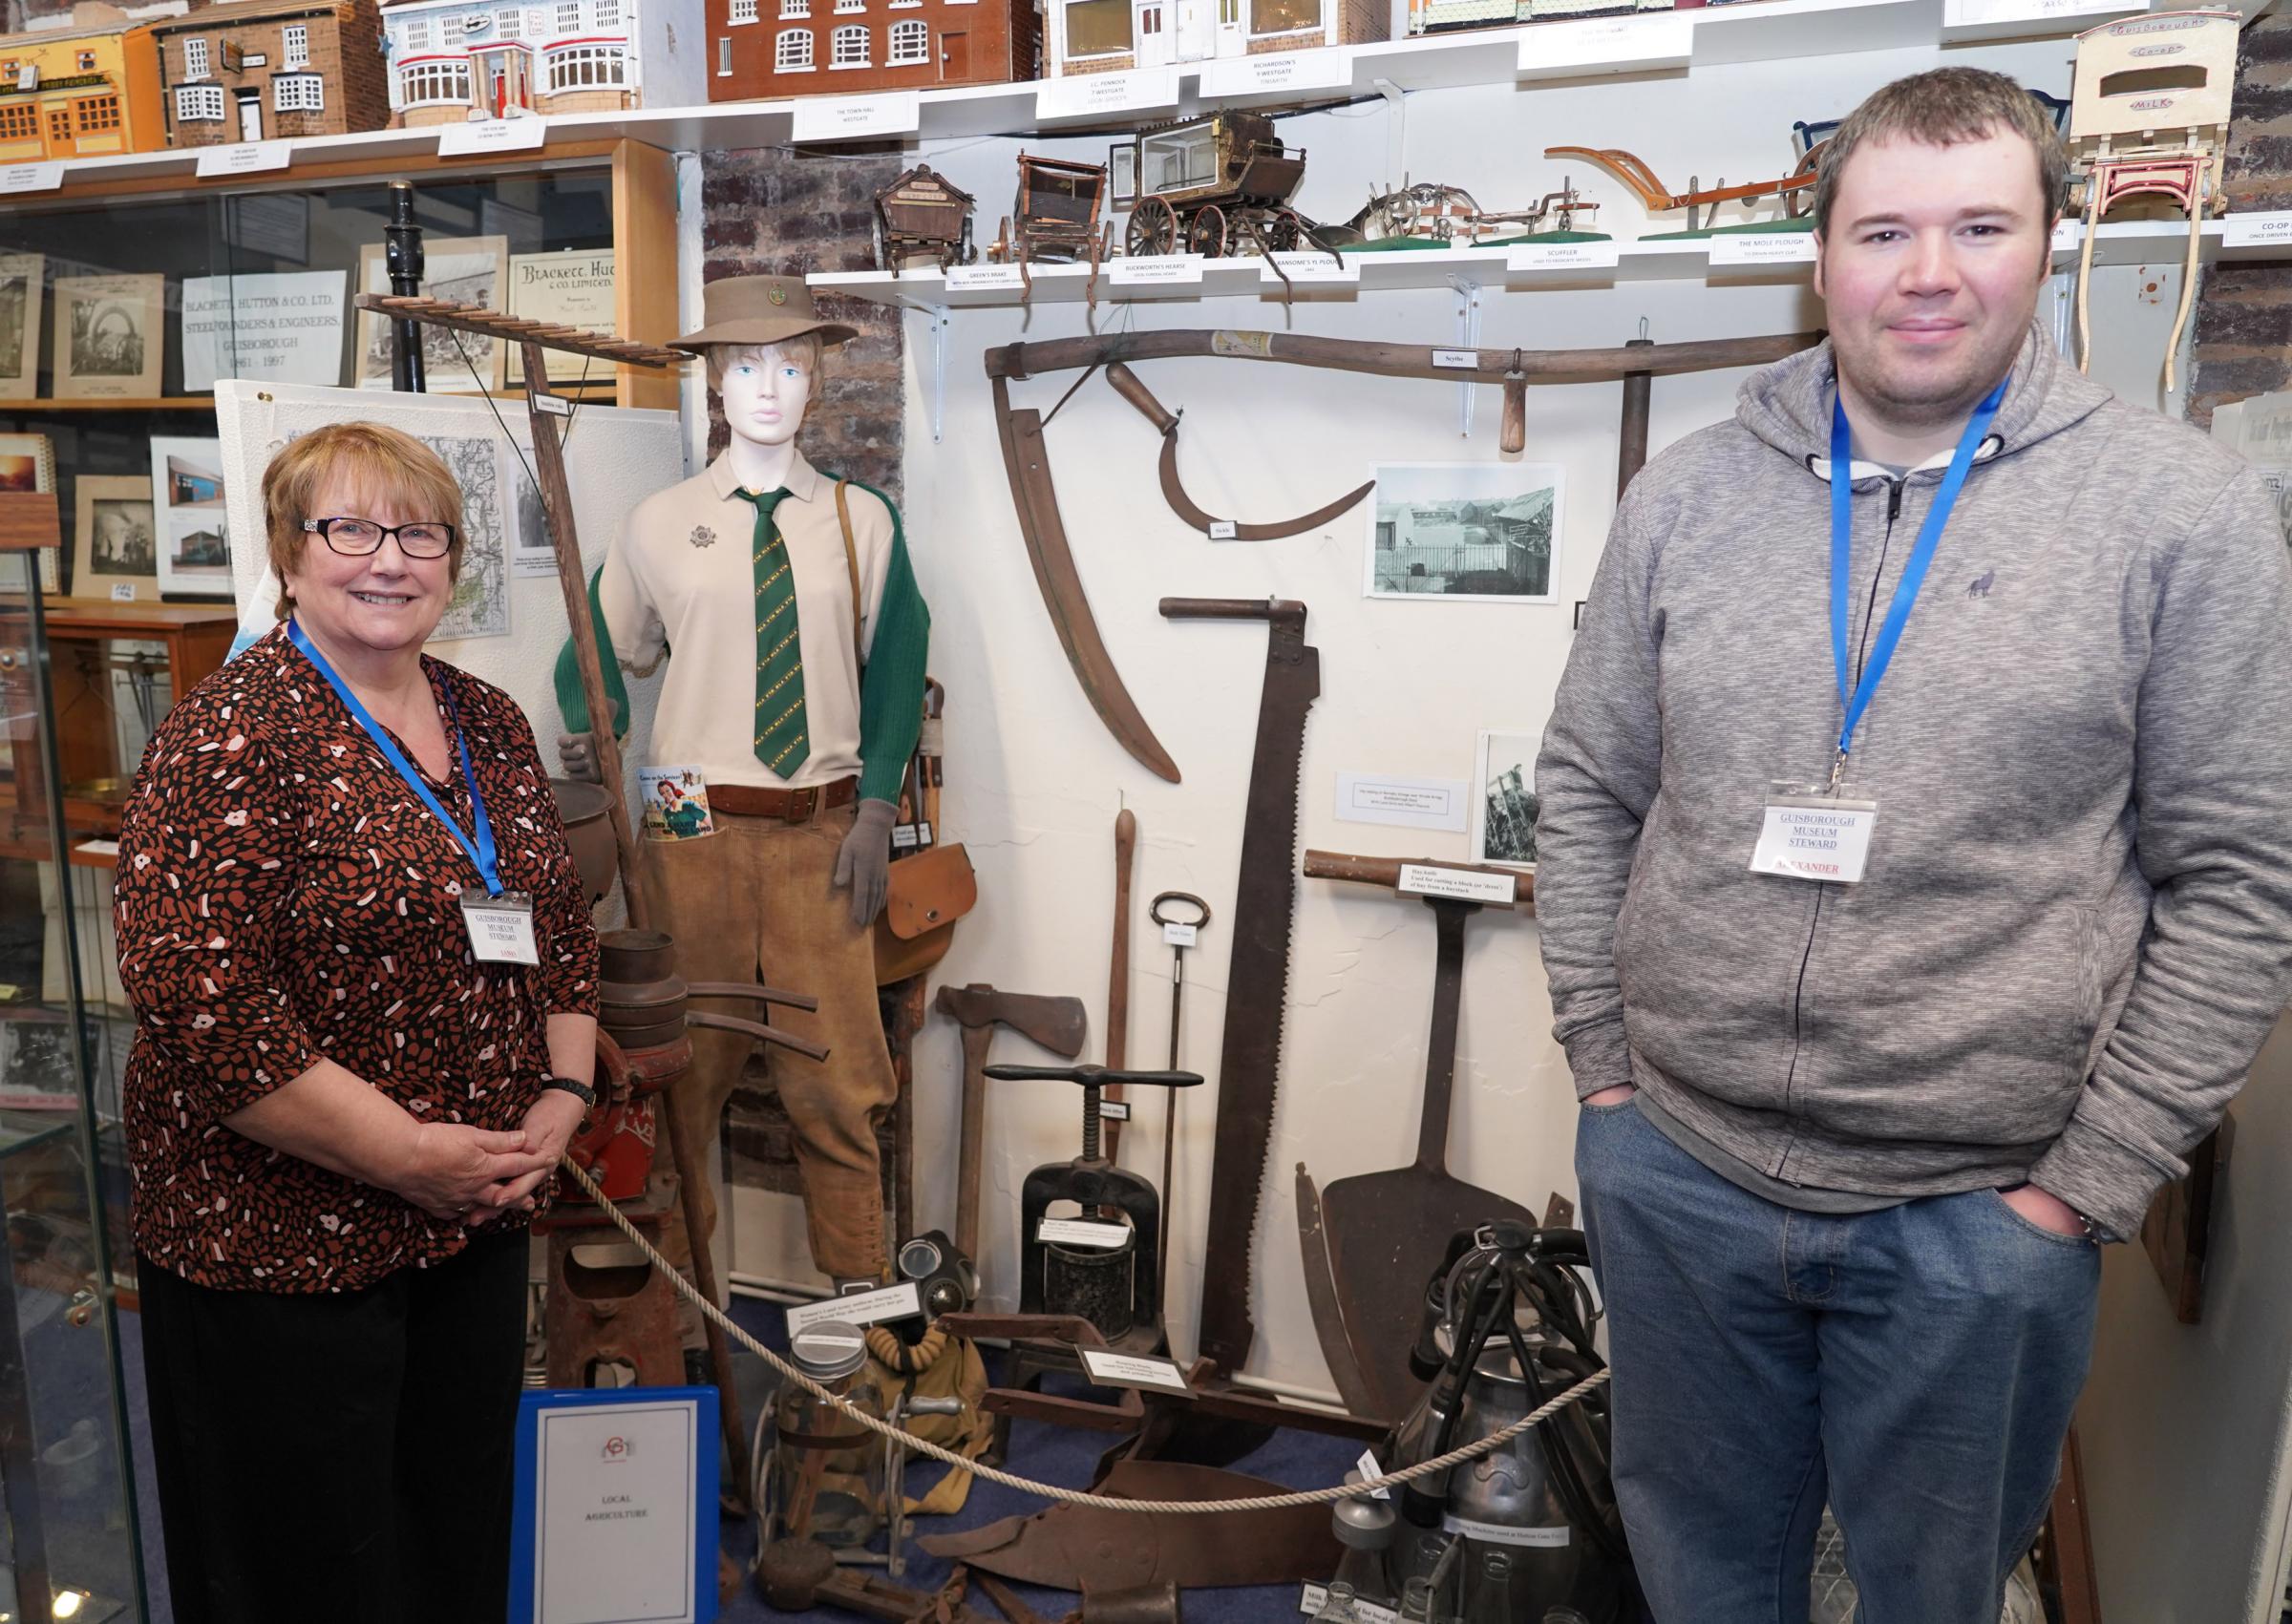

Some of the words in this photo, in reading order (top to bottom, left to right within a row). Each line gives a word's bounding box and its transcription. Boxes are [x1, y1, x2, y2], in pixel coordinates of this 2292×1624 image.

[238, 297, 279, 309] HUTTON
[1779, 812, 1856, 826] GUISBOROUGH
[1793, 826, 1837, 837] MUSEUM
[1788, 837, 1837, 849] STEWARD
[475, 915, 521, 924] GUISBOROUGH
[487, 924, 514, 933] MUSEUM
[602, 1494, 631, 1505] LOCAL
[584, 1508, 648, 1522] AGRICULTURE
[1307, 1591, 1322, 1601] Milk
